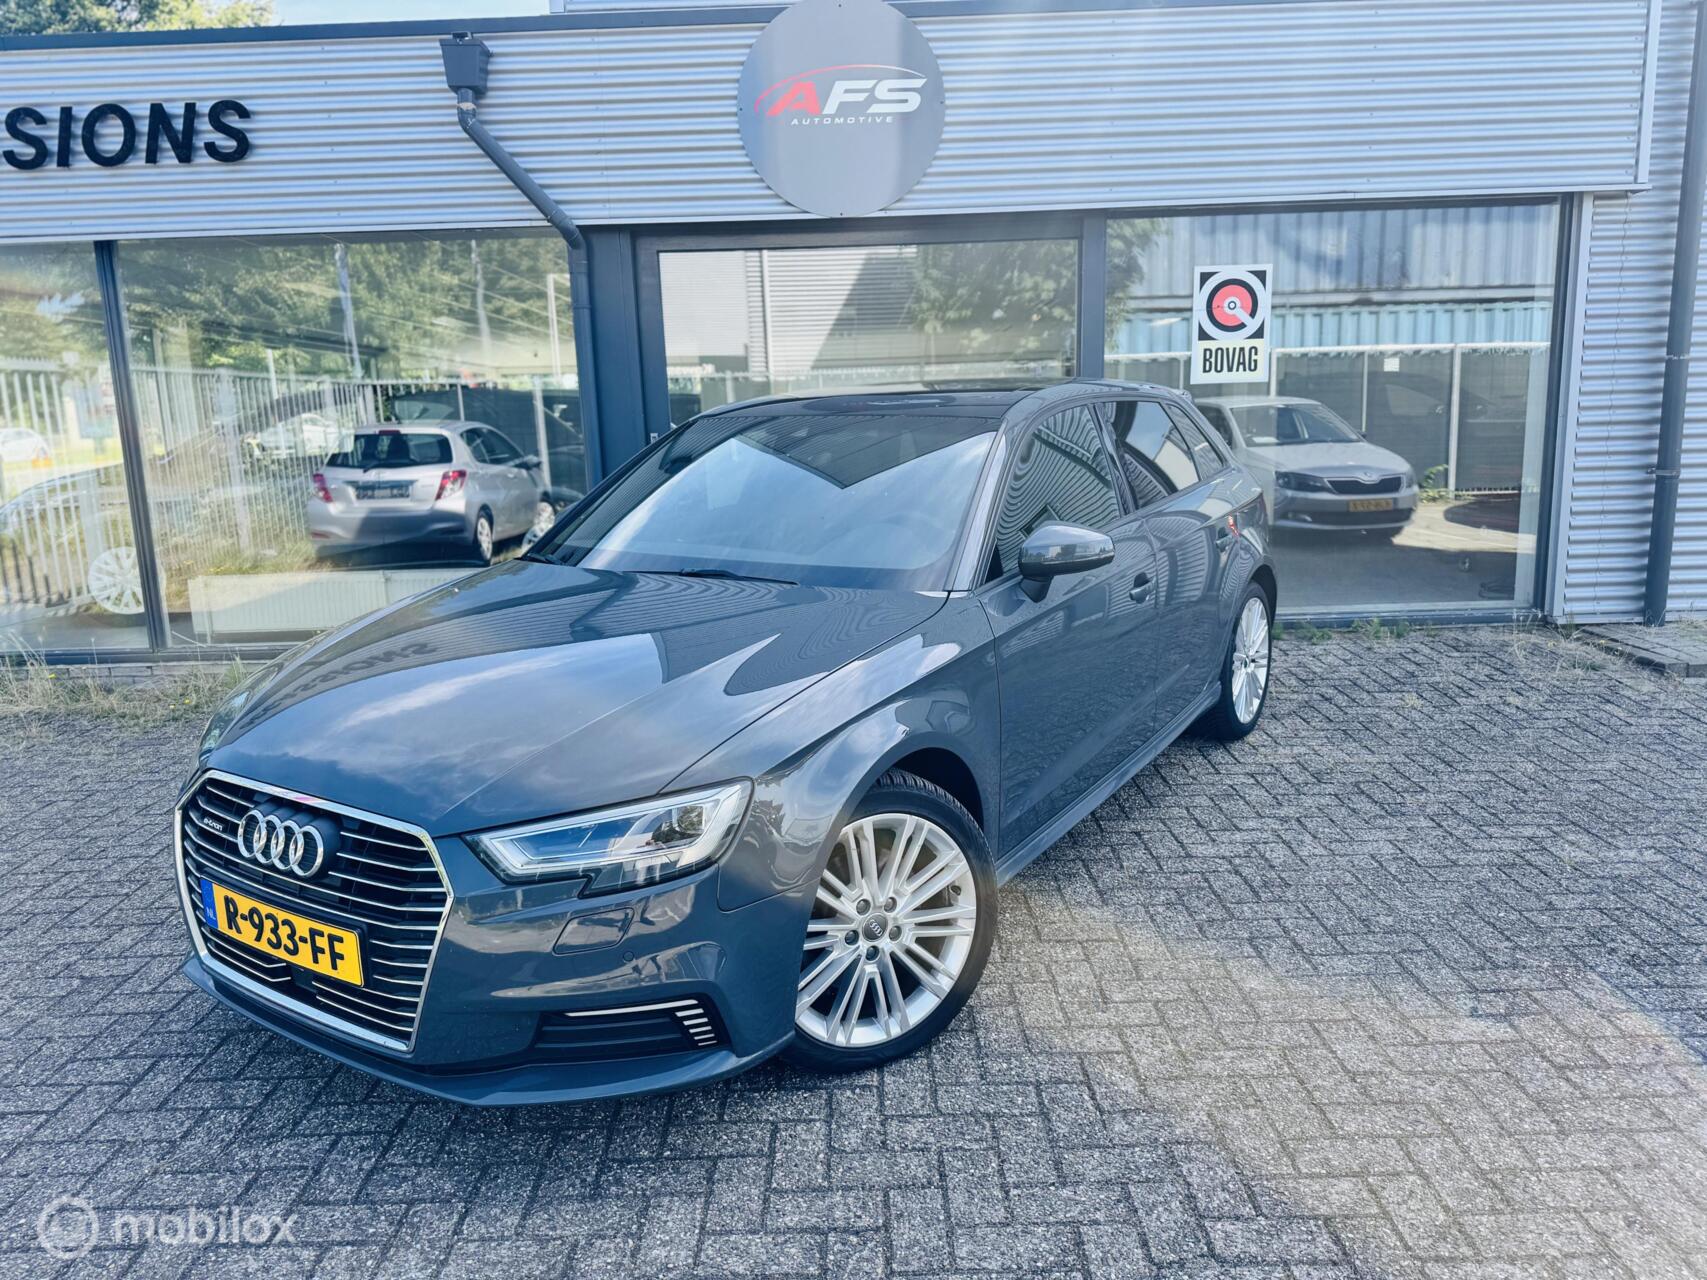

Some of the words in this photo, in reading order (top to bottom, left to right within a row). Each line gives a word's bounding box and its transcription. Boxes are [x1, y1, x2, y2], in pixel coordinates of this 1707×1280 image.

[767, 78, 928, 117] AFS
[2, 99, 251, 171] SIONS
[791, 115, 894, 126] AUTOMOTIVE
[1202, 346, 1259, 374] BOVAG
[223, 894, 345, 971] R-933-FF
